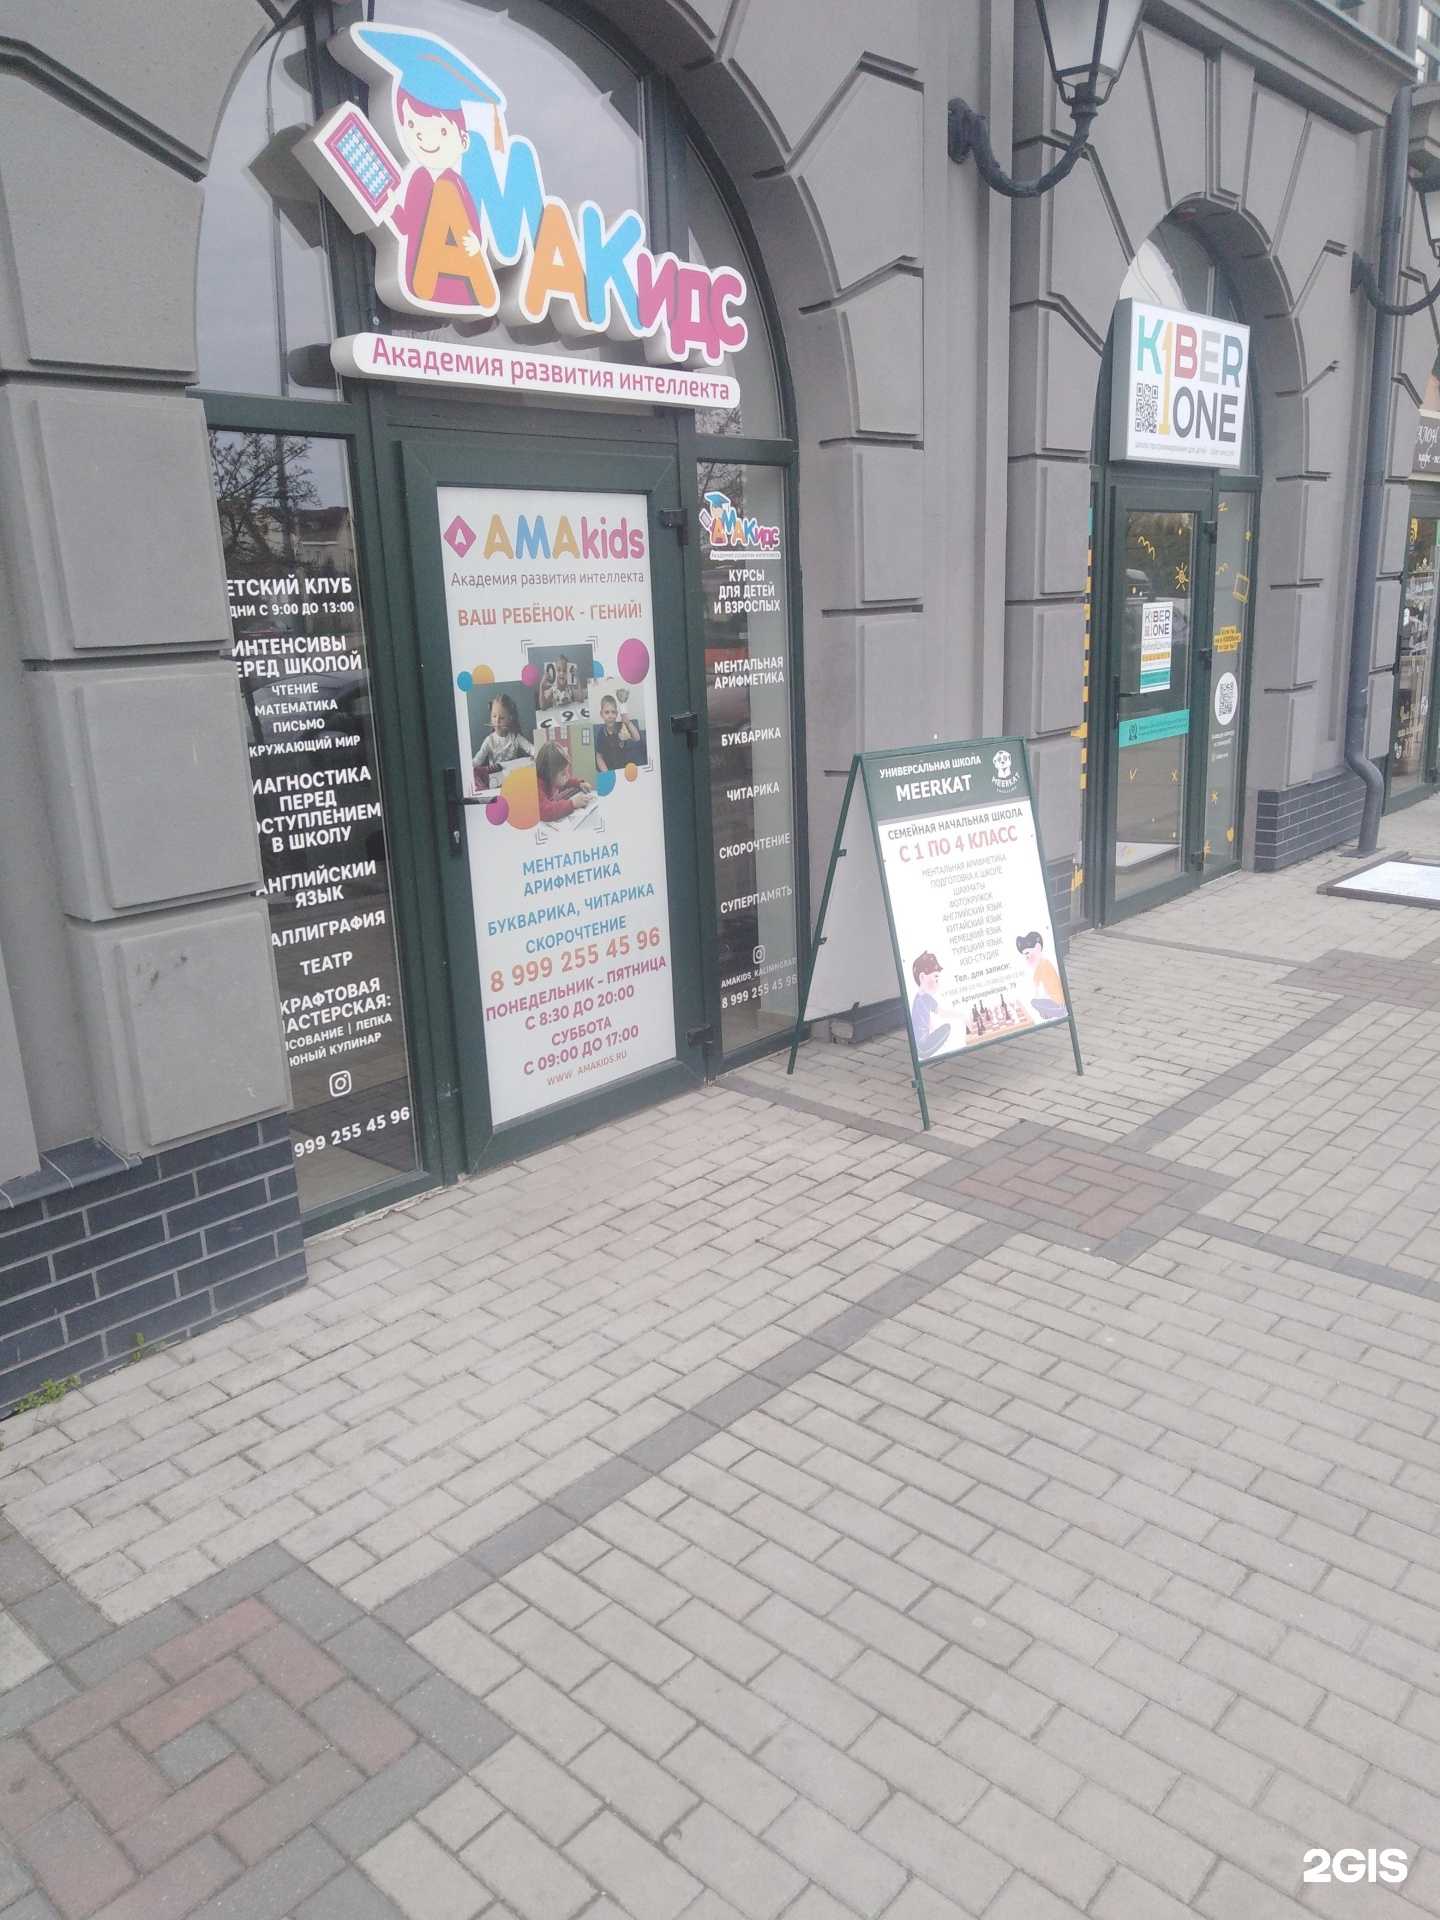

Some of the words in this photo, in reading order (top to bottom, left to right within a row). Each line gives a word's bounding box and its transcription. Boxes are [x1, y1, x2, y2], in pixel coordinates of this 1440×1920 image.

[372, 337, 504, 377] Академия
[511, 353, 613, 390] развития
[619, 371, 730, 401] интеллекта
[1137, 315, 1243, 396] KIBER
[1172, 386, 1239, 443] ONE
[483, 513, 645, 560] AMAkids
[226, 574, 300, 597] ЕТСКИЙ
[305, 577, 352, 595] КЛУБ
[451, 572, 517, 588] Академия
[521, 573, 577, 588] развития
[579, 570, 645, 584] интеллекта
[728, 569, 765, 582] КУРСЫ
[718, 585, 741, 601] ДЛЯ
[743, 581, 776, 598] ДЕТЕЙ
[230, 603, 256, 618] ДНИ
[259, 605, 269, 616] С
[272, 603, 299, 616] 9:00
[302, 602, 319, 616] ДО
[322, 601, 355, 613] 13:00
[458, 608, 497, 626] ВАШ
[502, 602, 575, 625] РЕБЁНОК
[589, 599, 642, 620] ГЕНИЙ!
[714, 602, 722, 614] И
[725, 599, 781, 614] ВЗРОСЛЫХ
[1152, 623, 1170, 637] ONE
[231, 635, 347, 657] ИНТЕНСИВЫ
[236, 659, 280, 678] ЕРЕД
[284, 650, 362, 675] ШКОЛОЙ
[714, 656, 784, 674] МЕНТАЛЬНАЯ
[271, 682, 319, 696] ЧТЕНИЕ
[714, 671, 785, 689] АРИФМЕТИКА
[254, 699, 338, 717] МАТЕМАТИКА
[272, 718, 325, 734] ПИСЬМО
[721, 727, 782, 747] БУКВАРИКА
[249, 735, 332, 758] КРУЖАЮЩИЙ
[335, 735, 361, 748] МИР
[252, 765, 372, 795] ИАГНОСТИКА
[879, 759, 951, 779] УНИВЕРСАЛЬНАЯ
[952, 755, 982, 769] ШКОЛА
[279, 789, 338, 813] ПЕРЕД
[726, 781, 780, 801] ЧИТАРИКА
[896, 774, 973, 802] MEERKAT
[257, 802, 381, 835] СТУПЛЕНИЕМ
[888, 823, 937, 841] СЕМЕЙНАЯ
[938, 813, 990, 832] НАЧАЛЬНАЯ
[991, 807, 1023, 822] ШКОЛА
[271, 837, 284, 853] В
[289, 825, 352, 850] ШКОЛУ
[719, 832, 791, 860] СКОРОЧТЕНИЕ
[899, 846, 911, 863] С
[915, 842, 924, 860] 1
[927, 837, 951, 859] ПО
[954, 836, 965, 853] 4
[968, 825, 1018, 849] КЛАСС
[522, 843, 619, 876] МЕНТАЛЬНАЯ
[524, 862, 622, 896] АРИФМЕТИКА
[295, 884, 345, 909] ЯЗЫК
[487, 902, 581, 937] БУКВАРИКА,
[584, 883, 655, 911] ЧИТАРИКА
[720, 885, 793, 914] СУПЕРПАМЯТЬ
[271, 909, 386, 948] АЛЛИГРАФИЯ
[525, 915, 627, 955] СКОРОЧТЕНИЕ
[299, 951, 353, 976] ТЕАТР
[490, 970, 505, 993] 8
[511, 957, 553, 986] 999
[560, 944, 599, 972] 255
[605, 935, 630, 959] 45
[636, 926, 661, 950] 96
[971, 969, 984, 980] для
[280, 977, 381, 1016] КРАФТОВАЯ
[485, 976, 594, 1022] ПОНЕДЕЛЬНИК
[607, 956, 667, 985] ПЯТНИЦА
[721, 997, 729, 1009] 8
[730, 990, 749, 1006] 999
[751, 983, 769, 999] 255
[771, 978, 783, 990] 45
[282, 993, 392, 1034] АСТЕРСКАЯ:
[524, 1016, 536, 1031] С
[539, 1005, 570, 1026] 8:30
[573, 997, 594, 1018] ДО
[597, 984, 634, 1008] 20:00
[285, 1026, 344, 1051] СОВАНИЕ
[356, 1013, 393, 1031] ЛЕПКА
[551, 1016, 613, 1047] СУББОТА
[289, 1046, 327, 1067] ЮНЫЙ
[329, 1032, 382, 1056] КУЛИНАР
[523, 1061, 535, 1076] С
[538, 1046, 579, 1071] 09:00
[581, 1037, 603, 1058] ДО
[605, 1024, 639, 1048] 17:00
[293, 1135, 326, 1158] 999
[331, 1122, 362, 1146] 255
[366, 1114, 387, 1132] 45
[390, 1106, 411, 1125] 96
